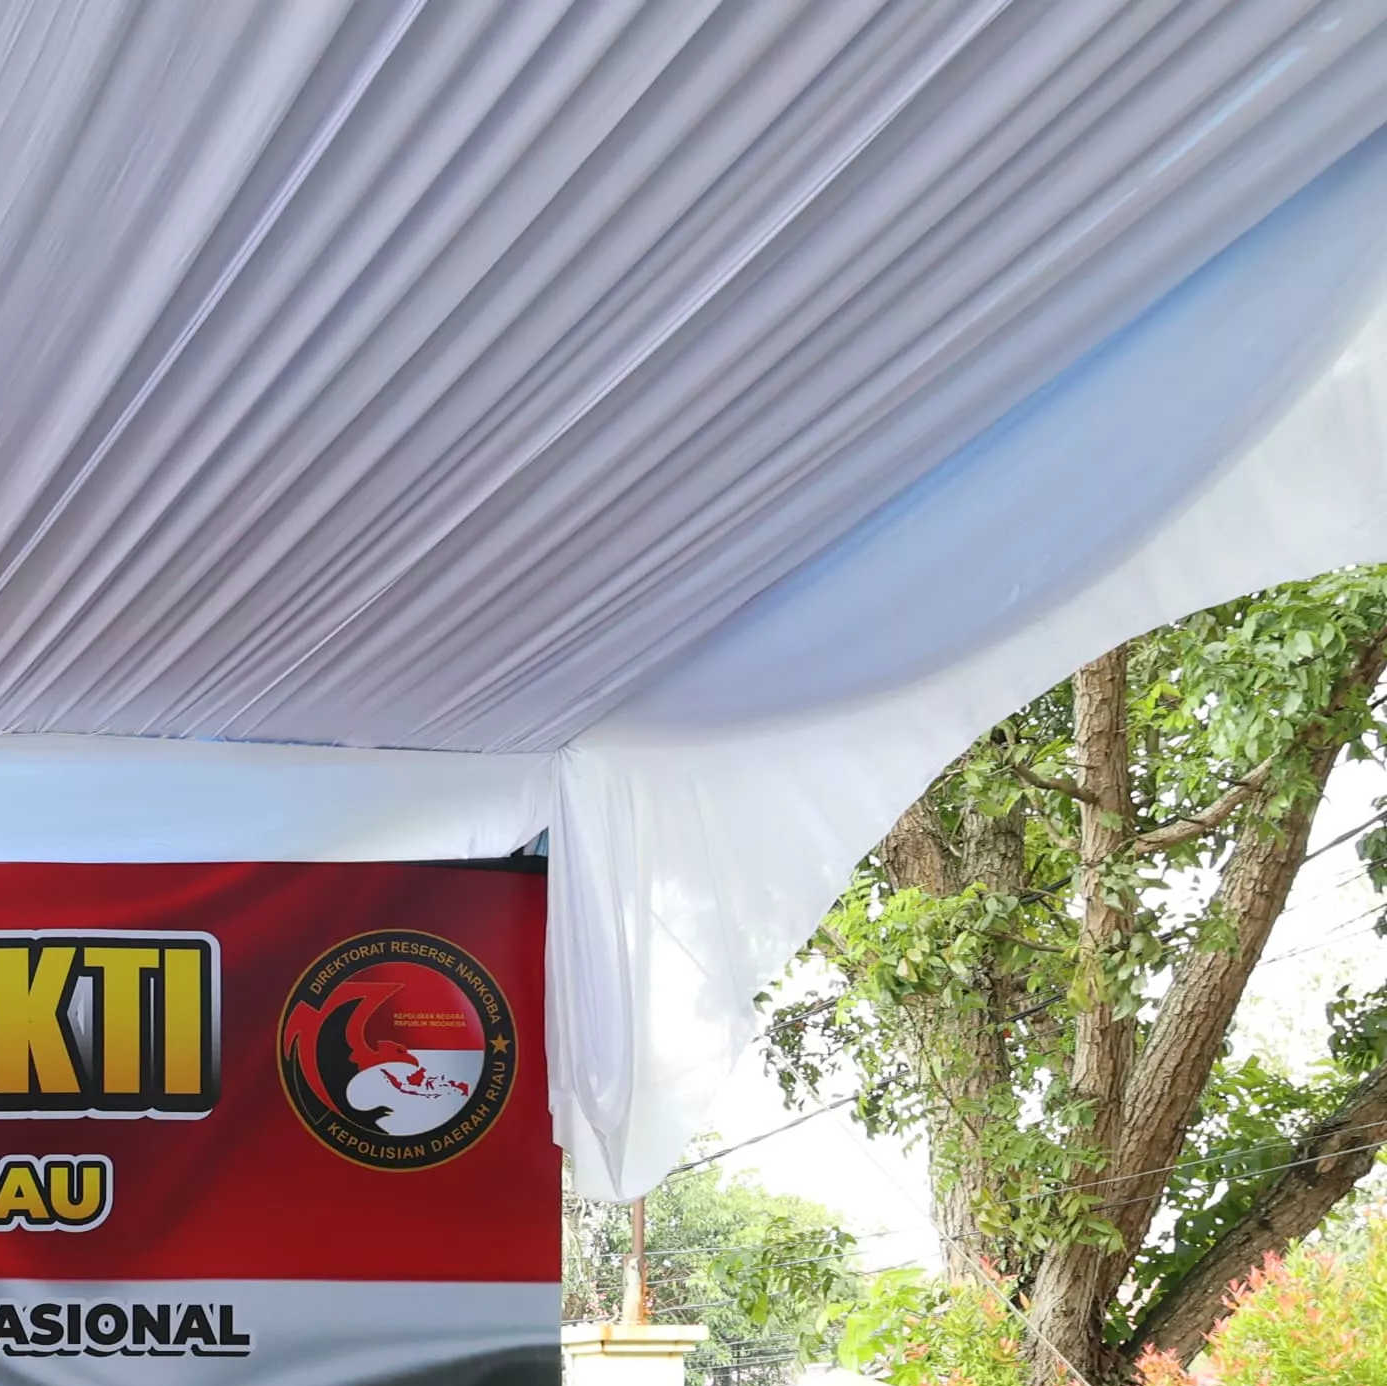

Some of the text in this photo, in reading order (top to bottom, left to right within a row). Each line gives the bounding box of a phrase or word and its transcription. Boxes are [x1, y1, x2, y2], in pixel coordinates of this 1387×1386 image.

[309, 941, 502, 1025] DIREKTORAT RESERSE NARKOBA
[327, 1061, 506, 1160] KEPOLISIAN DAERAH RIAU
